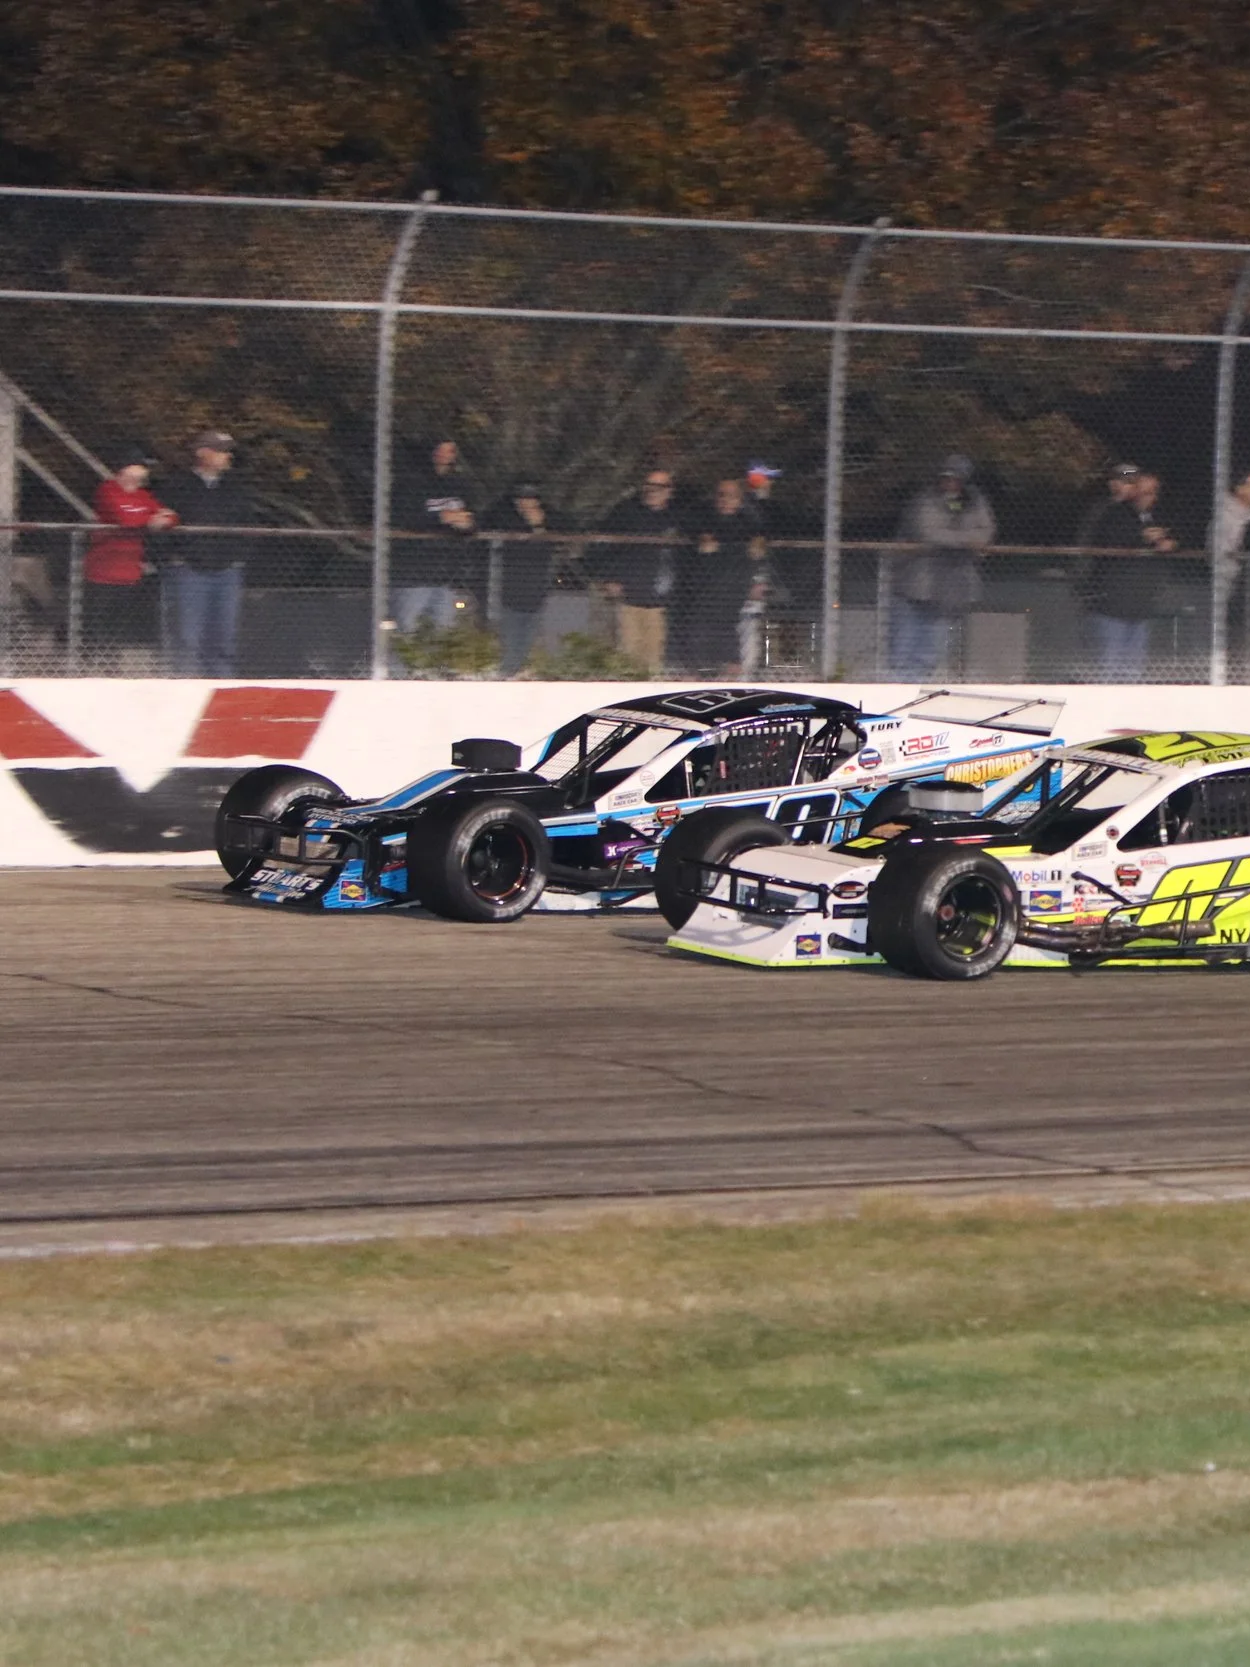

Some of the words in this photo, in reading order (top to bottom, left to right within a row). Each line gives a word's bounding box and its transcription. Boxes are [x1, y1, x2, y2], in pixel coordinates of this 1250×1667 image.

[870, 721, 902, 732] FURY
[1013, 870, 1047, 882] Mobil
[1051, 870, 1062, 881] 1
[1220, 928, 1246, 944] NY
